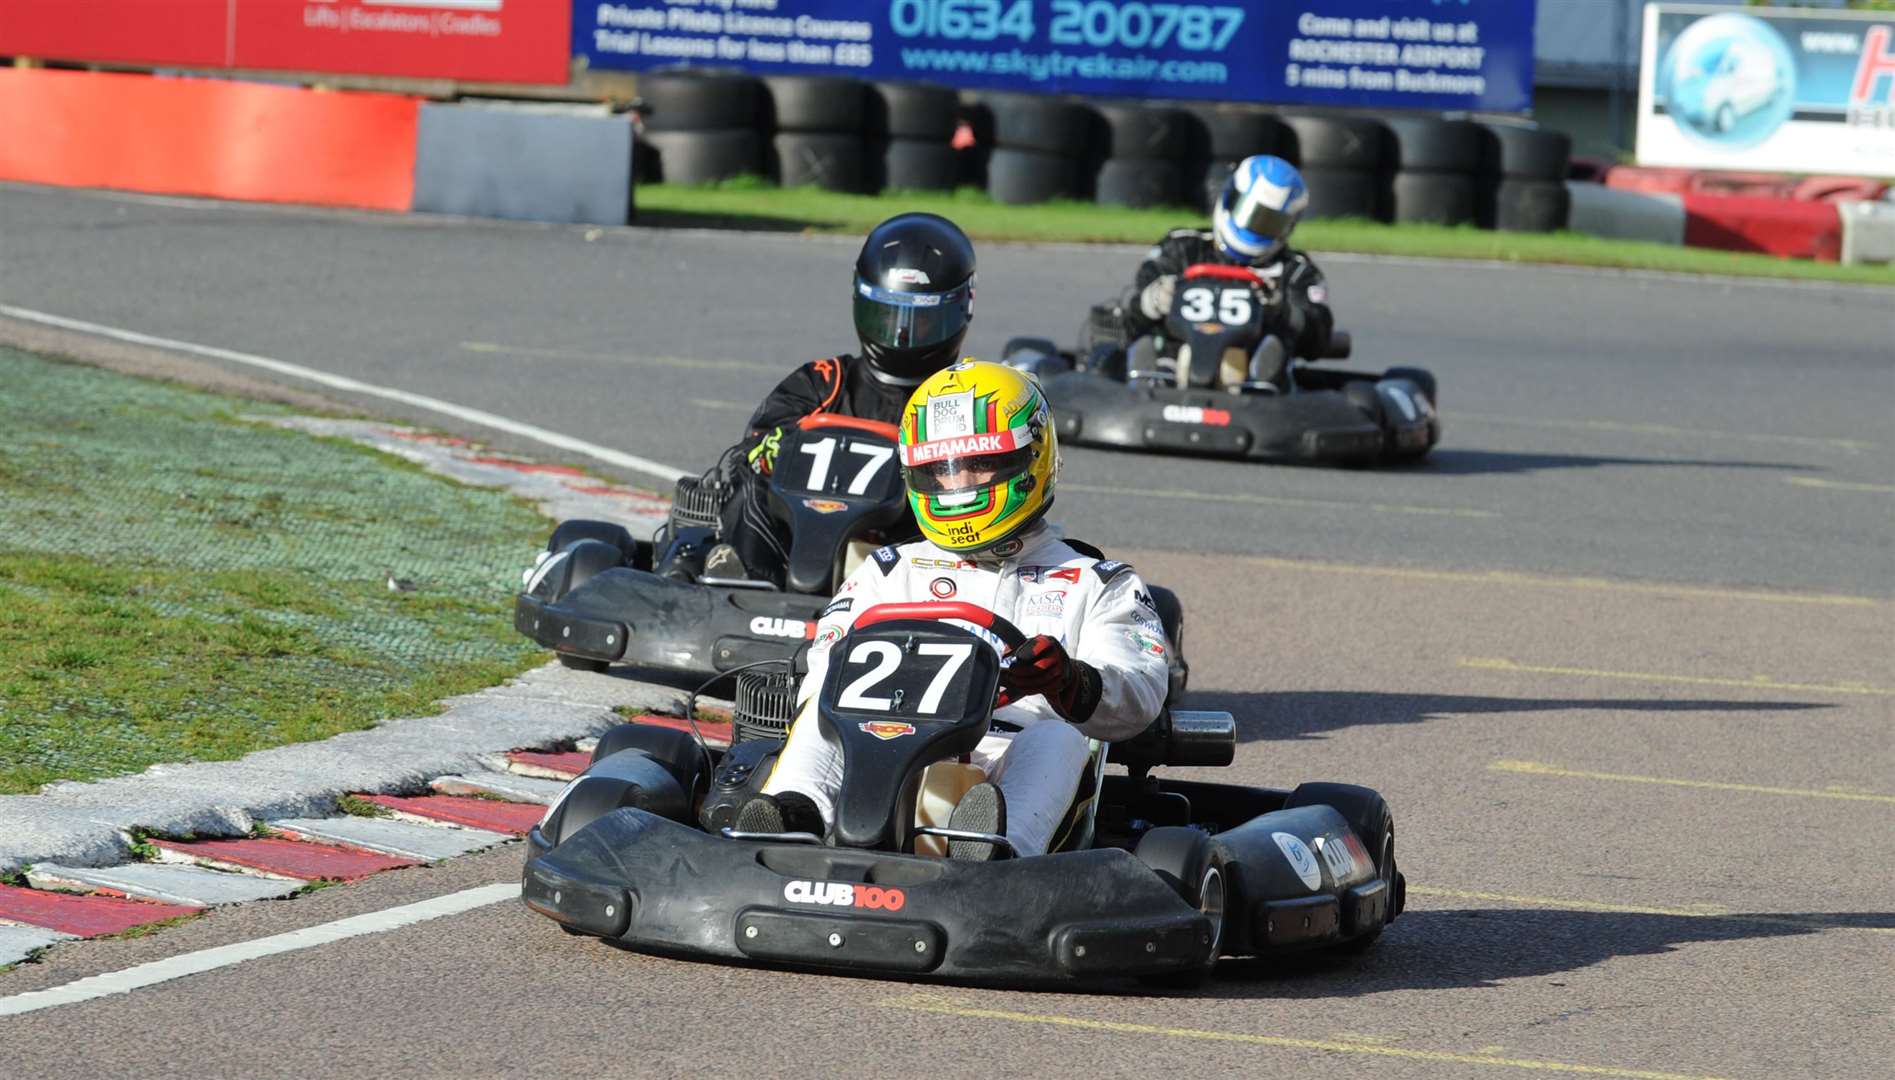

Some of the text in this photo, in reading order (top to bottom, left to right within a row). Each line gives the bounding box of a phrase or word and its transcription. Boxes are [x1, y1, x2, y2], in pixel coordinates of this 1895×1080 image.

[597, 4, 666, 29] Private
[796, 15, 872, 41] Courses
[889, 0, 1244, 50] 01634 200787
[1299, 12, 1478, 43] Come and visit us at
[595, 29, 639, 54] Trial
[640, 32, 716, 58] Lessons
[717, 36, 746, 59] for
[748, 38, 786, 62] less
[787, 40, 832, 64] than
[1289, 39, 1485, 69] ROCHESTER AIRPORT
[902, 48, 1227, 82] www.skytrekair.com
[1286, 63, 1486, 95] 5 mins from Buckmore
[1181, 288, 1252, 325] 35
[934, 399, 960, 409] BULL
[913, 435, 1002, 463] METAMARK
[801, 437, 894, 495] 17
[947, 521, 973, 536] indi
[951, 532, 981, 544] seat
[838, 641, 973, 714] 27
[784, 880, 905, 911] CLUB100
